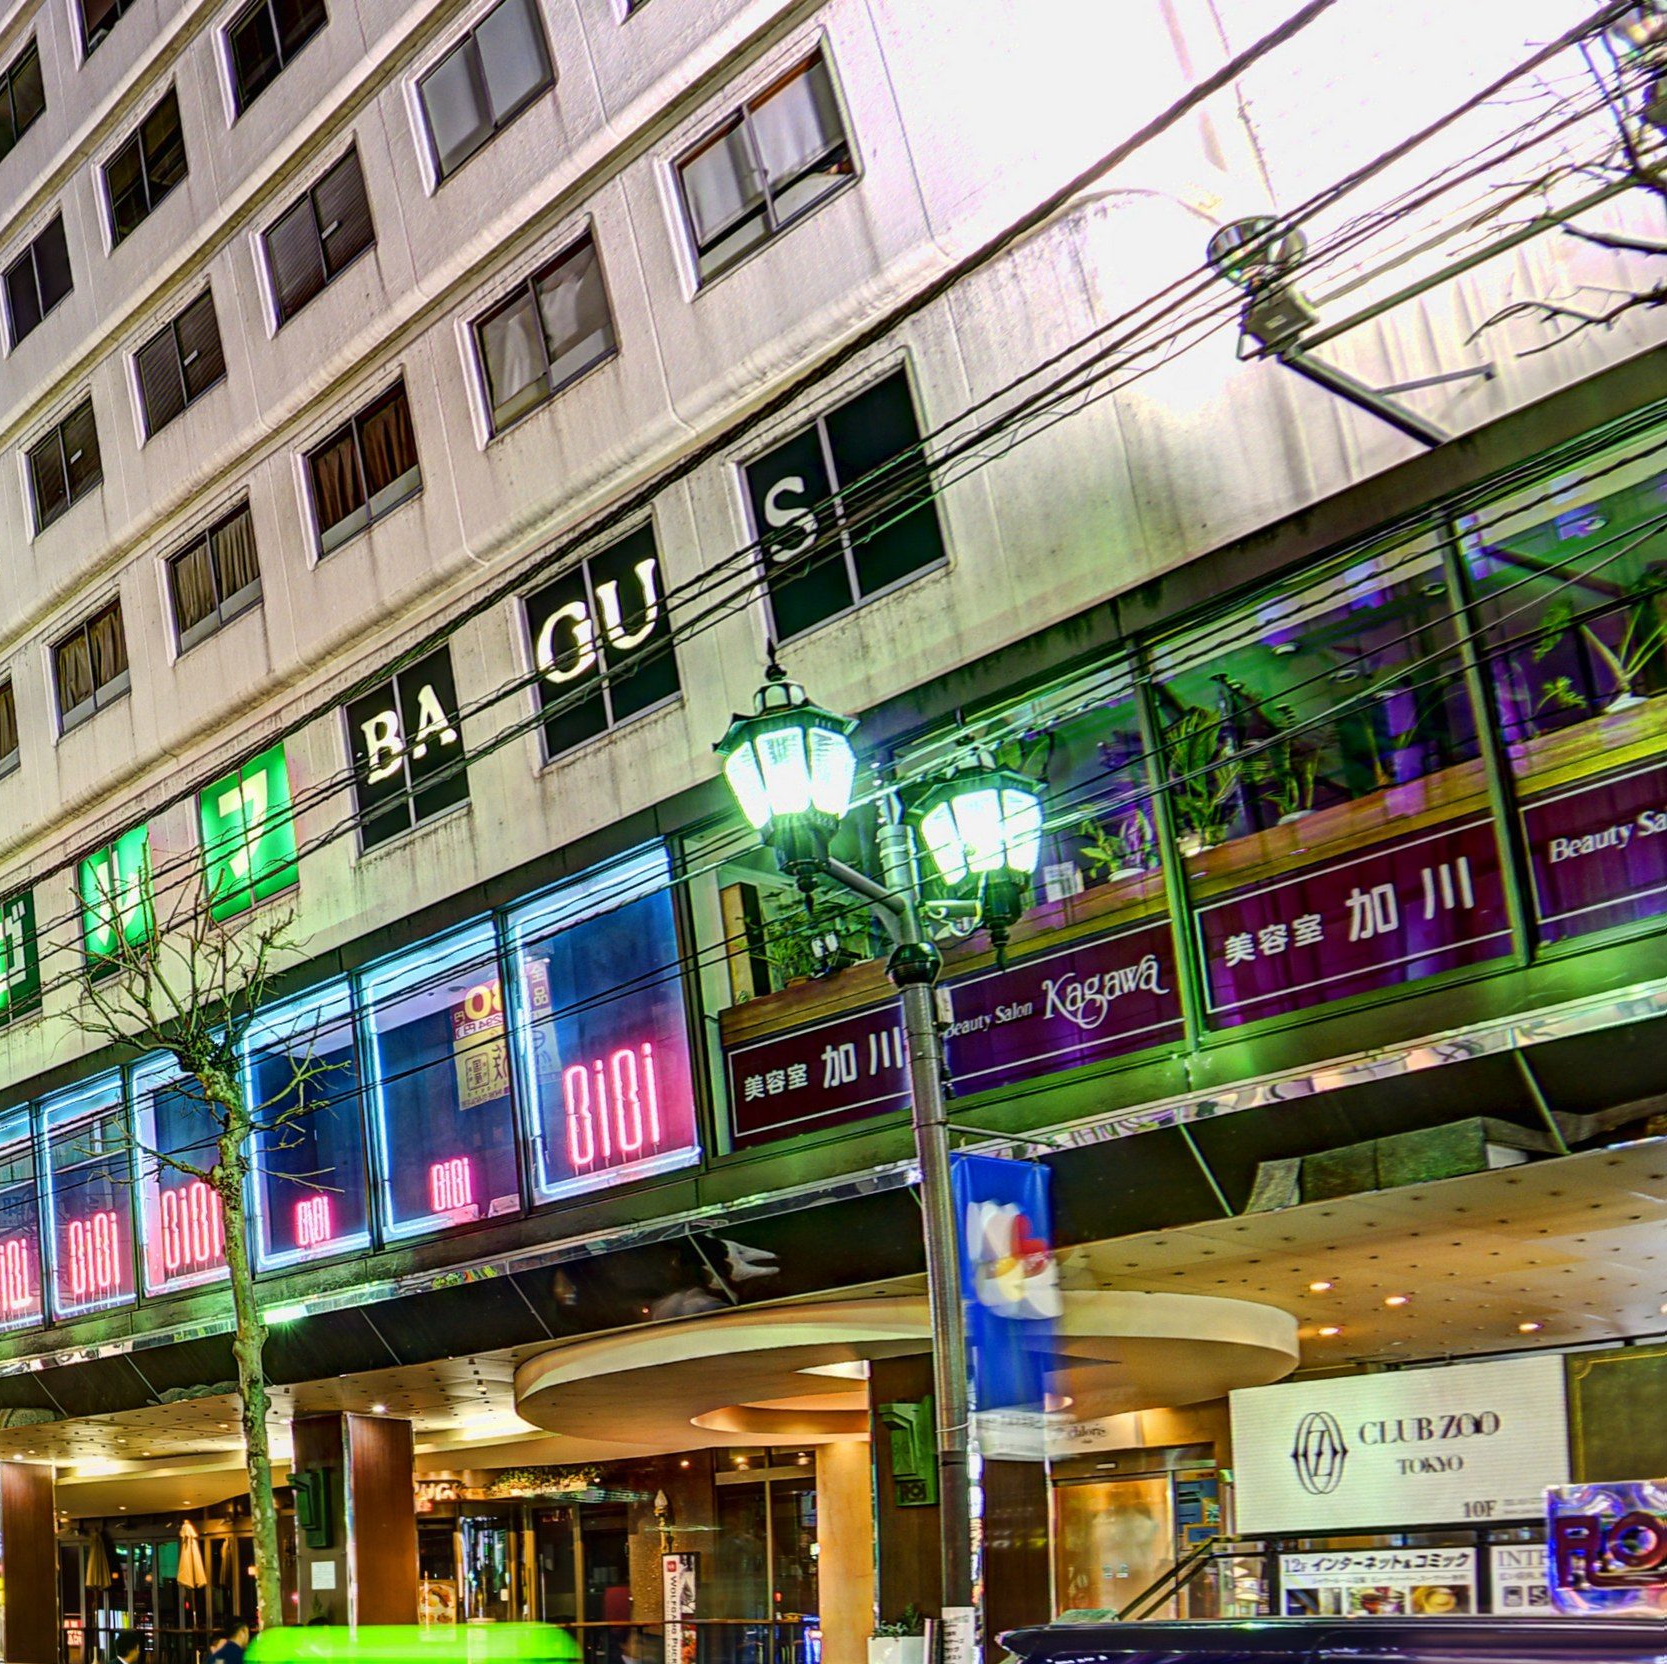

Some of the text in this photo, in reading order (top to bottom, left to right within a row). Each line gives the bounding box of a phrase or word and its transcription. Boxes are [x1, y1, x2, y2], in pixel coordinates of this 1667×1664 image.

[1549, 809, 1667, 863] Beauty Sa
[1223, 856, 1474, 968] 美容室 加川
[994, 999, 1033, 1024] Salon
[1043, 954, 1169, 1028] Kagawa
[743, 1027, 905, 1102] 美容室 加川
[1358, 1410, 1501, 1446] CLUB ZOO
[1396, 1454, 1465, 1476] TOKYO
[1463, 1500, 1497, 1519] 10F
[1311, 1552, 1470, 1573] インターネット&コミック
